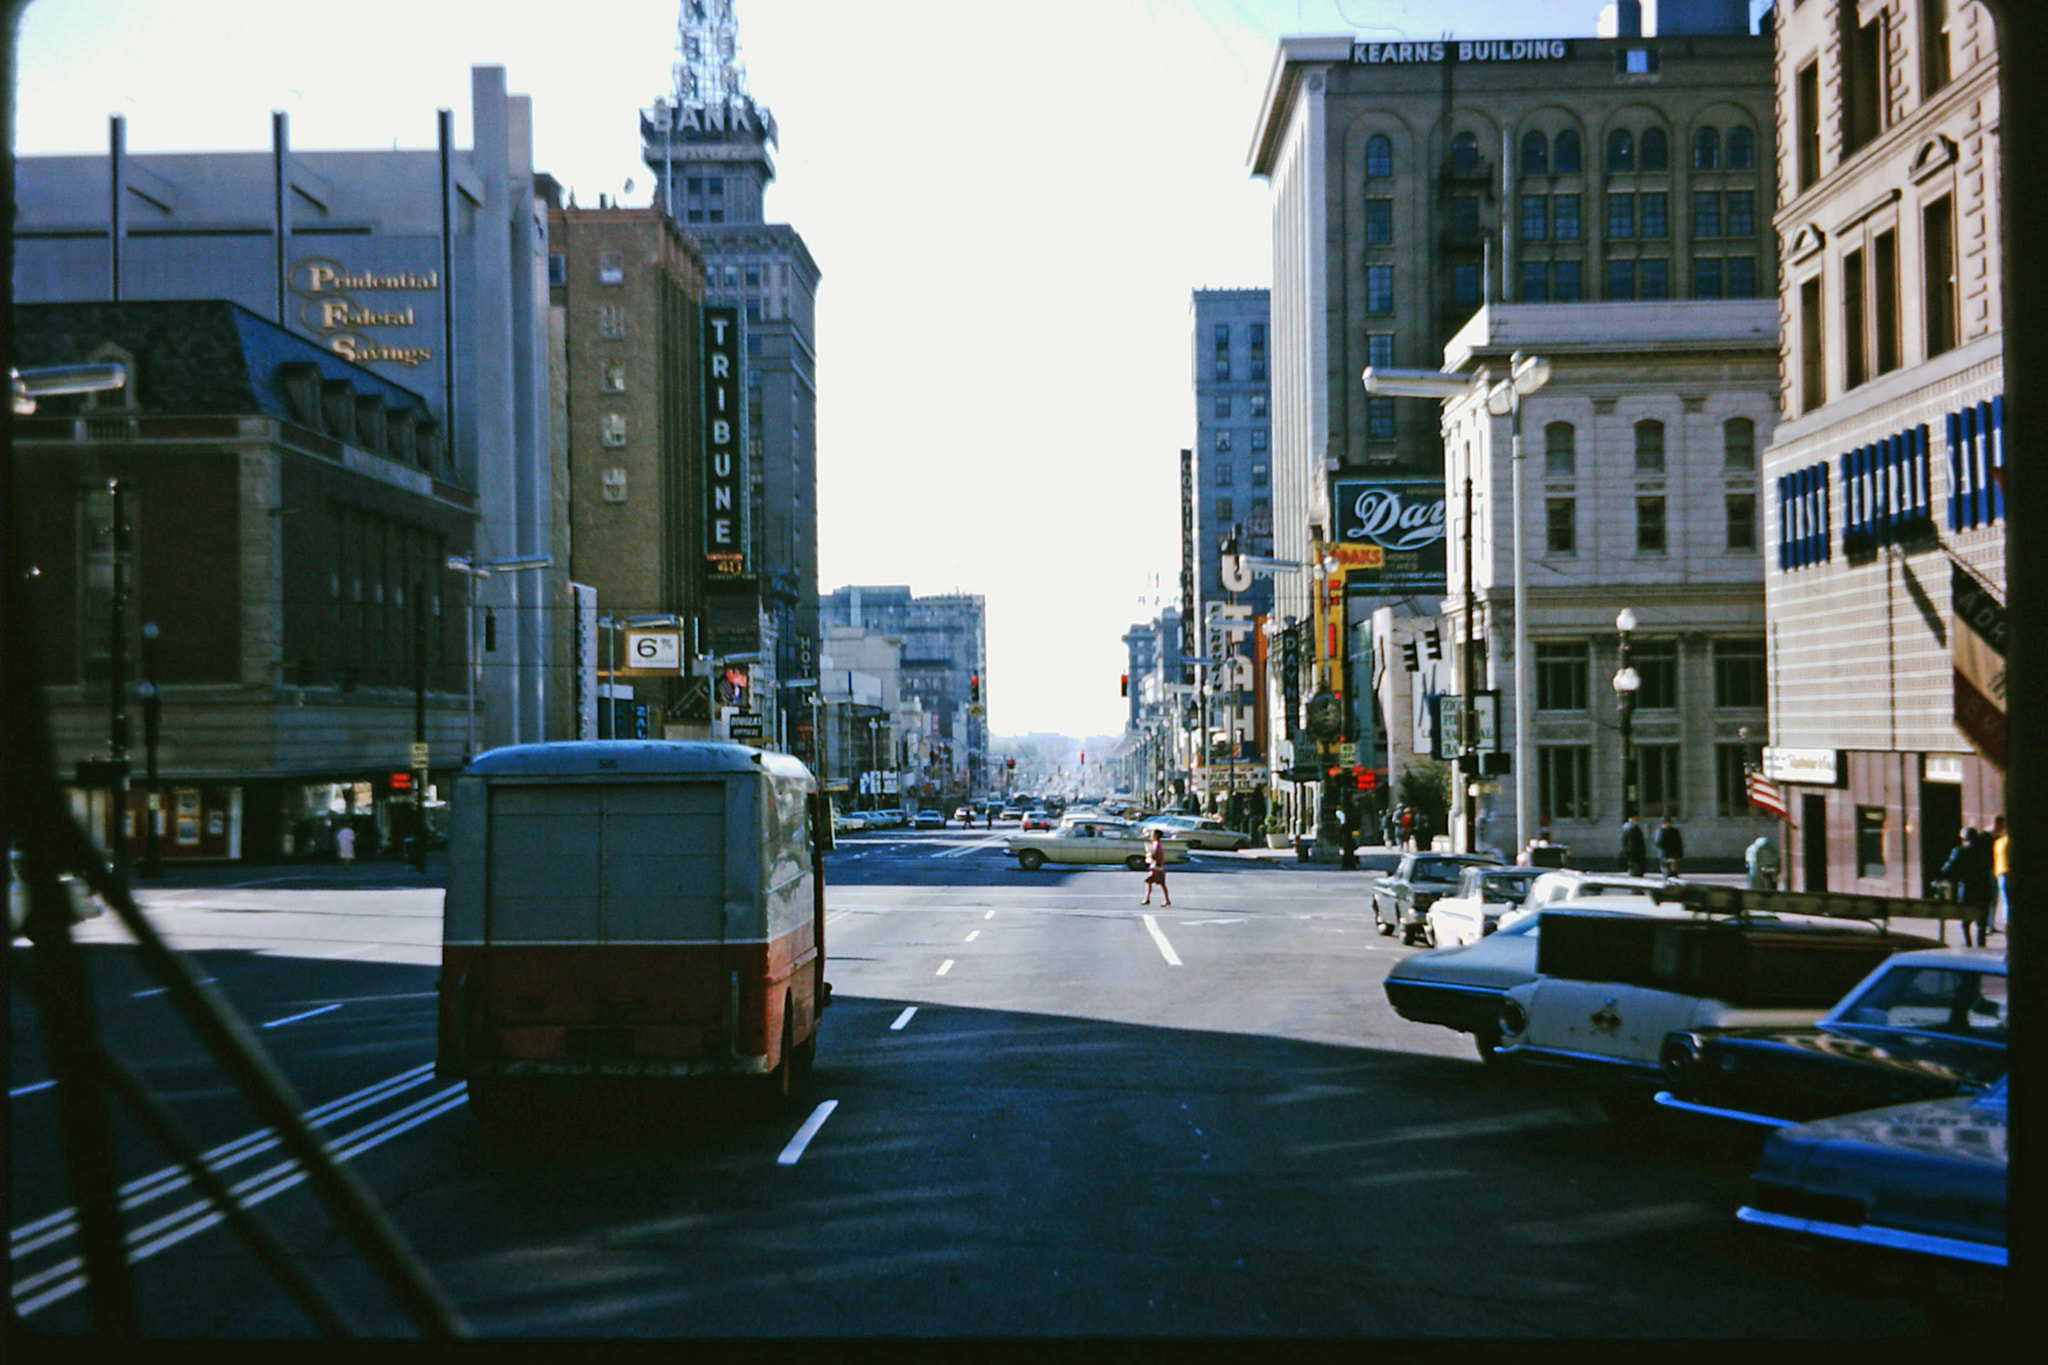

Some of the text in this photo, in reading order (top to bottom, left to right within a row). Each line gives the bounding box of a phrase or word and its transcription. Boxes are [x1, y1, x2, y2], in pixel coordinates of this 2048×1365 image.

[1354, 40, 1565, 63] KEARNS BUILDING
[654, 100, 751, 131] BANK
[309, 266, 438, 292] Prudential
[322, 302, 414, 328] Federal
[331, 336, 431, 367] Savings
[711, 318, 731, 543] TRIBUNE
[1182, 460, 1192, 606] CONTINENTAL
[1222, 553, 1254, 741] UTAH
[1285, 636, 1297, 736] DAYNES
[731, 716, 762, 726] DOUGLAS
